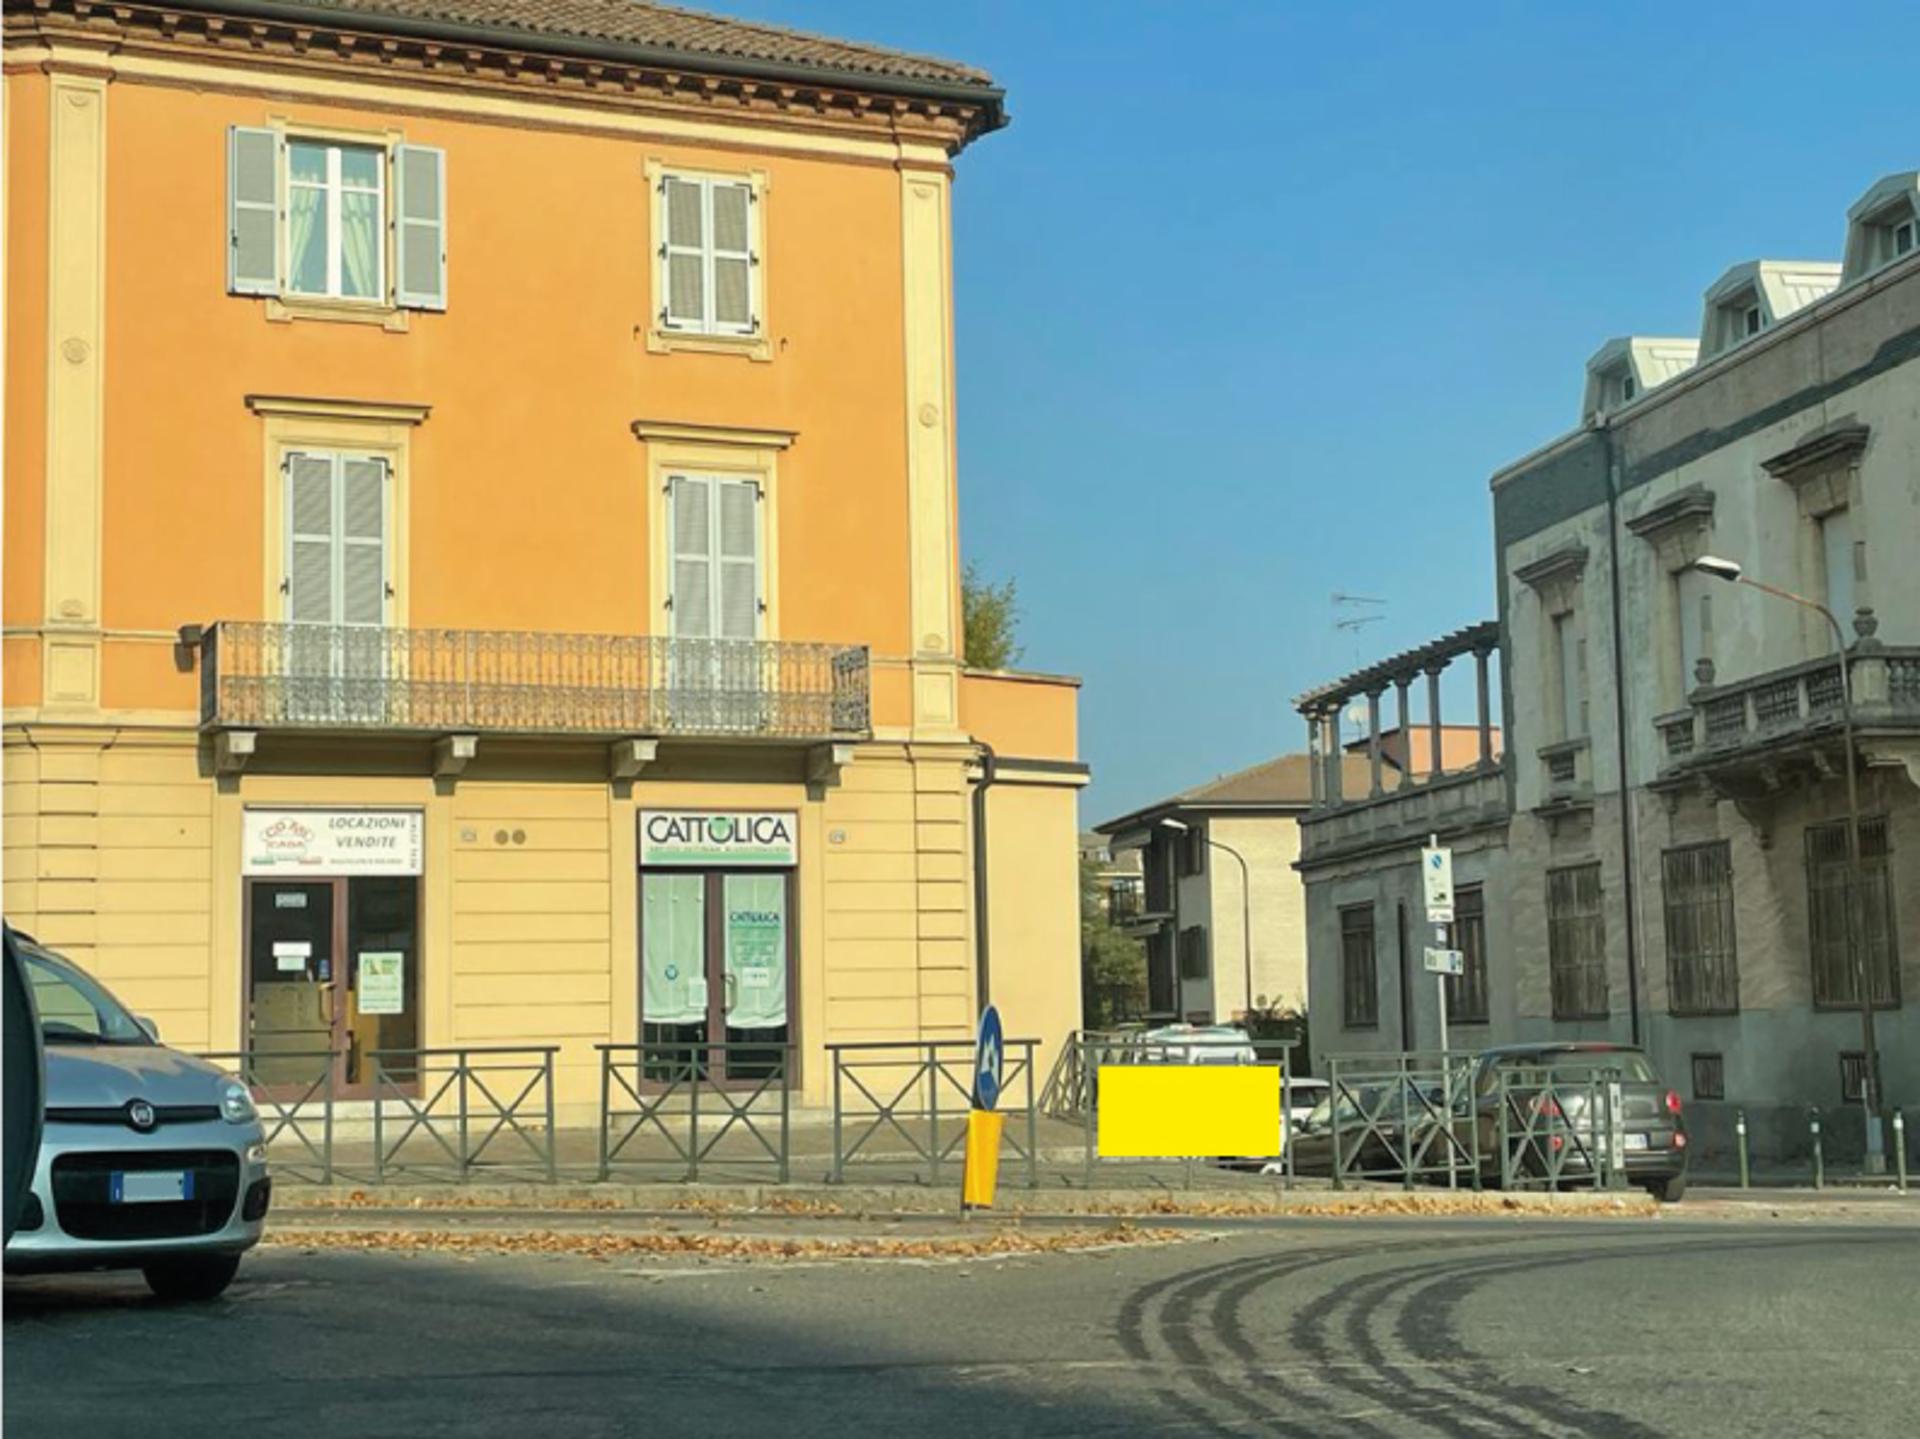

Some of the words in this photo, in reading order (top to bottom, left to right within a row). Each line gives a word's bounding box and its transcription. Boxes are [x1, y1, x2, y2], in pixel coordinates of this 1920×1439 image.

[328, 816, 406, 829] LOCAZIONI
[648, 815, 791, 844] CATTOLICA
[335, 835, 397, 849] VENDITE
